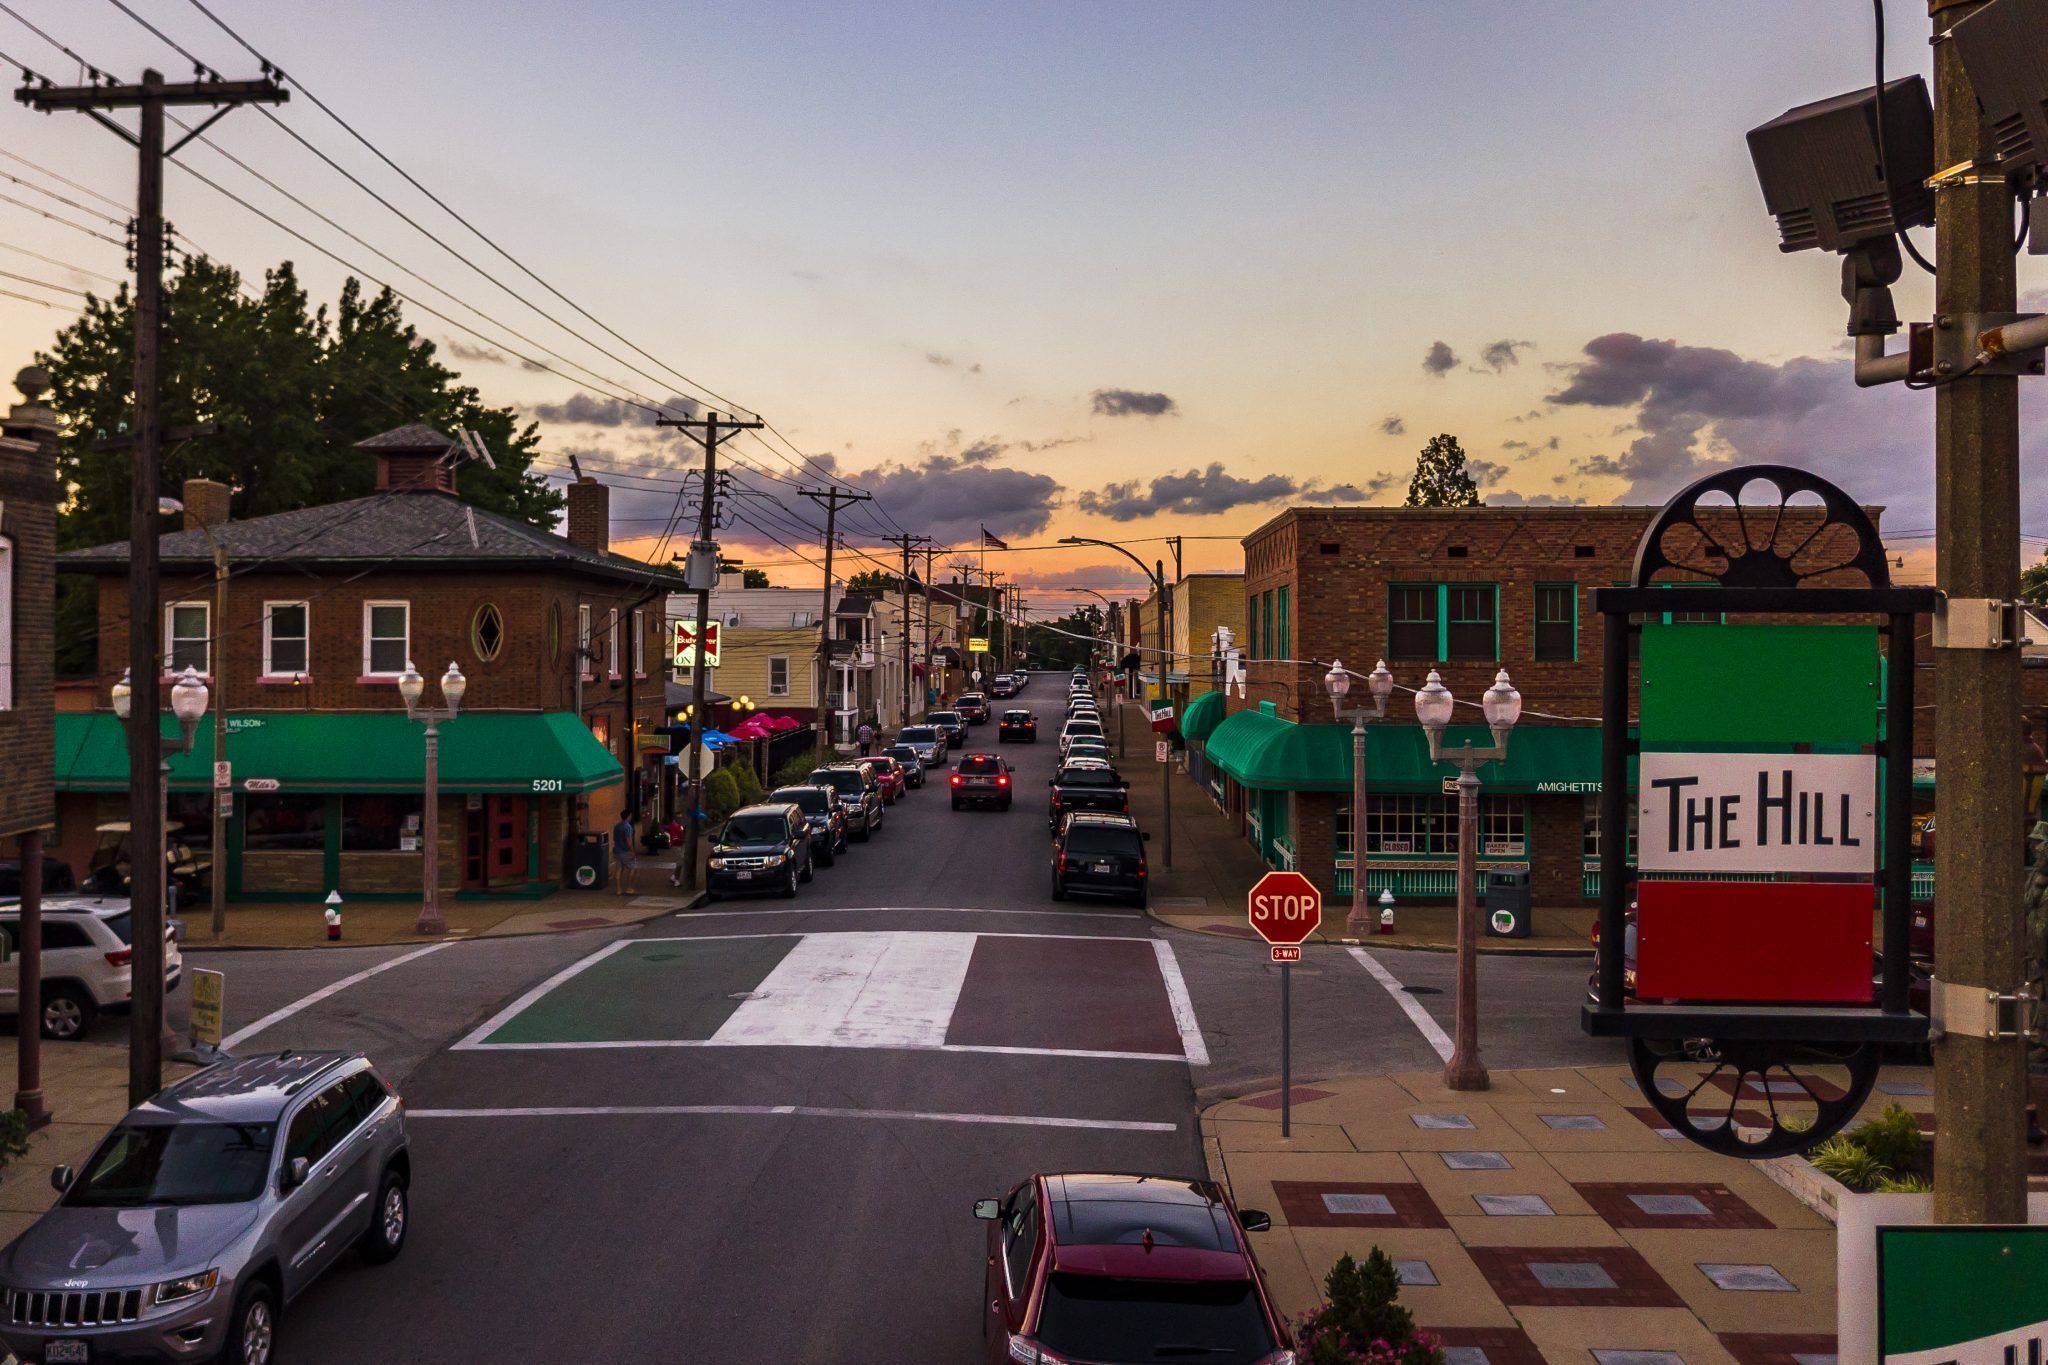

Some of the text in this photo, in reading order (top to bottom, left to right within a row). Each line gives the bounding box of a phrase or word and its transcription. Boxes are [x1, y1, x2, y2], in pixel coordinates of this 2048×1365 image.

[229, 719, 261, 727] WILSON
[533, 779, 562, 791] 5201
[1536, 782, 1602, 792] AMIGHETTI'S
[1651, 770, 1860, 852] THE HILL
[1384, 843, 1409, 851] CLOSED
[1254, 894, 1315, 921] STOP
[1274, 949, 1298, 958] 3-WAY
[64, 1279, 89, 1289] Jeep
